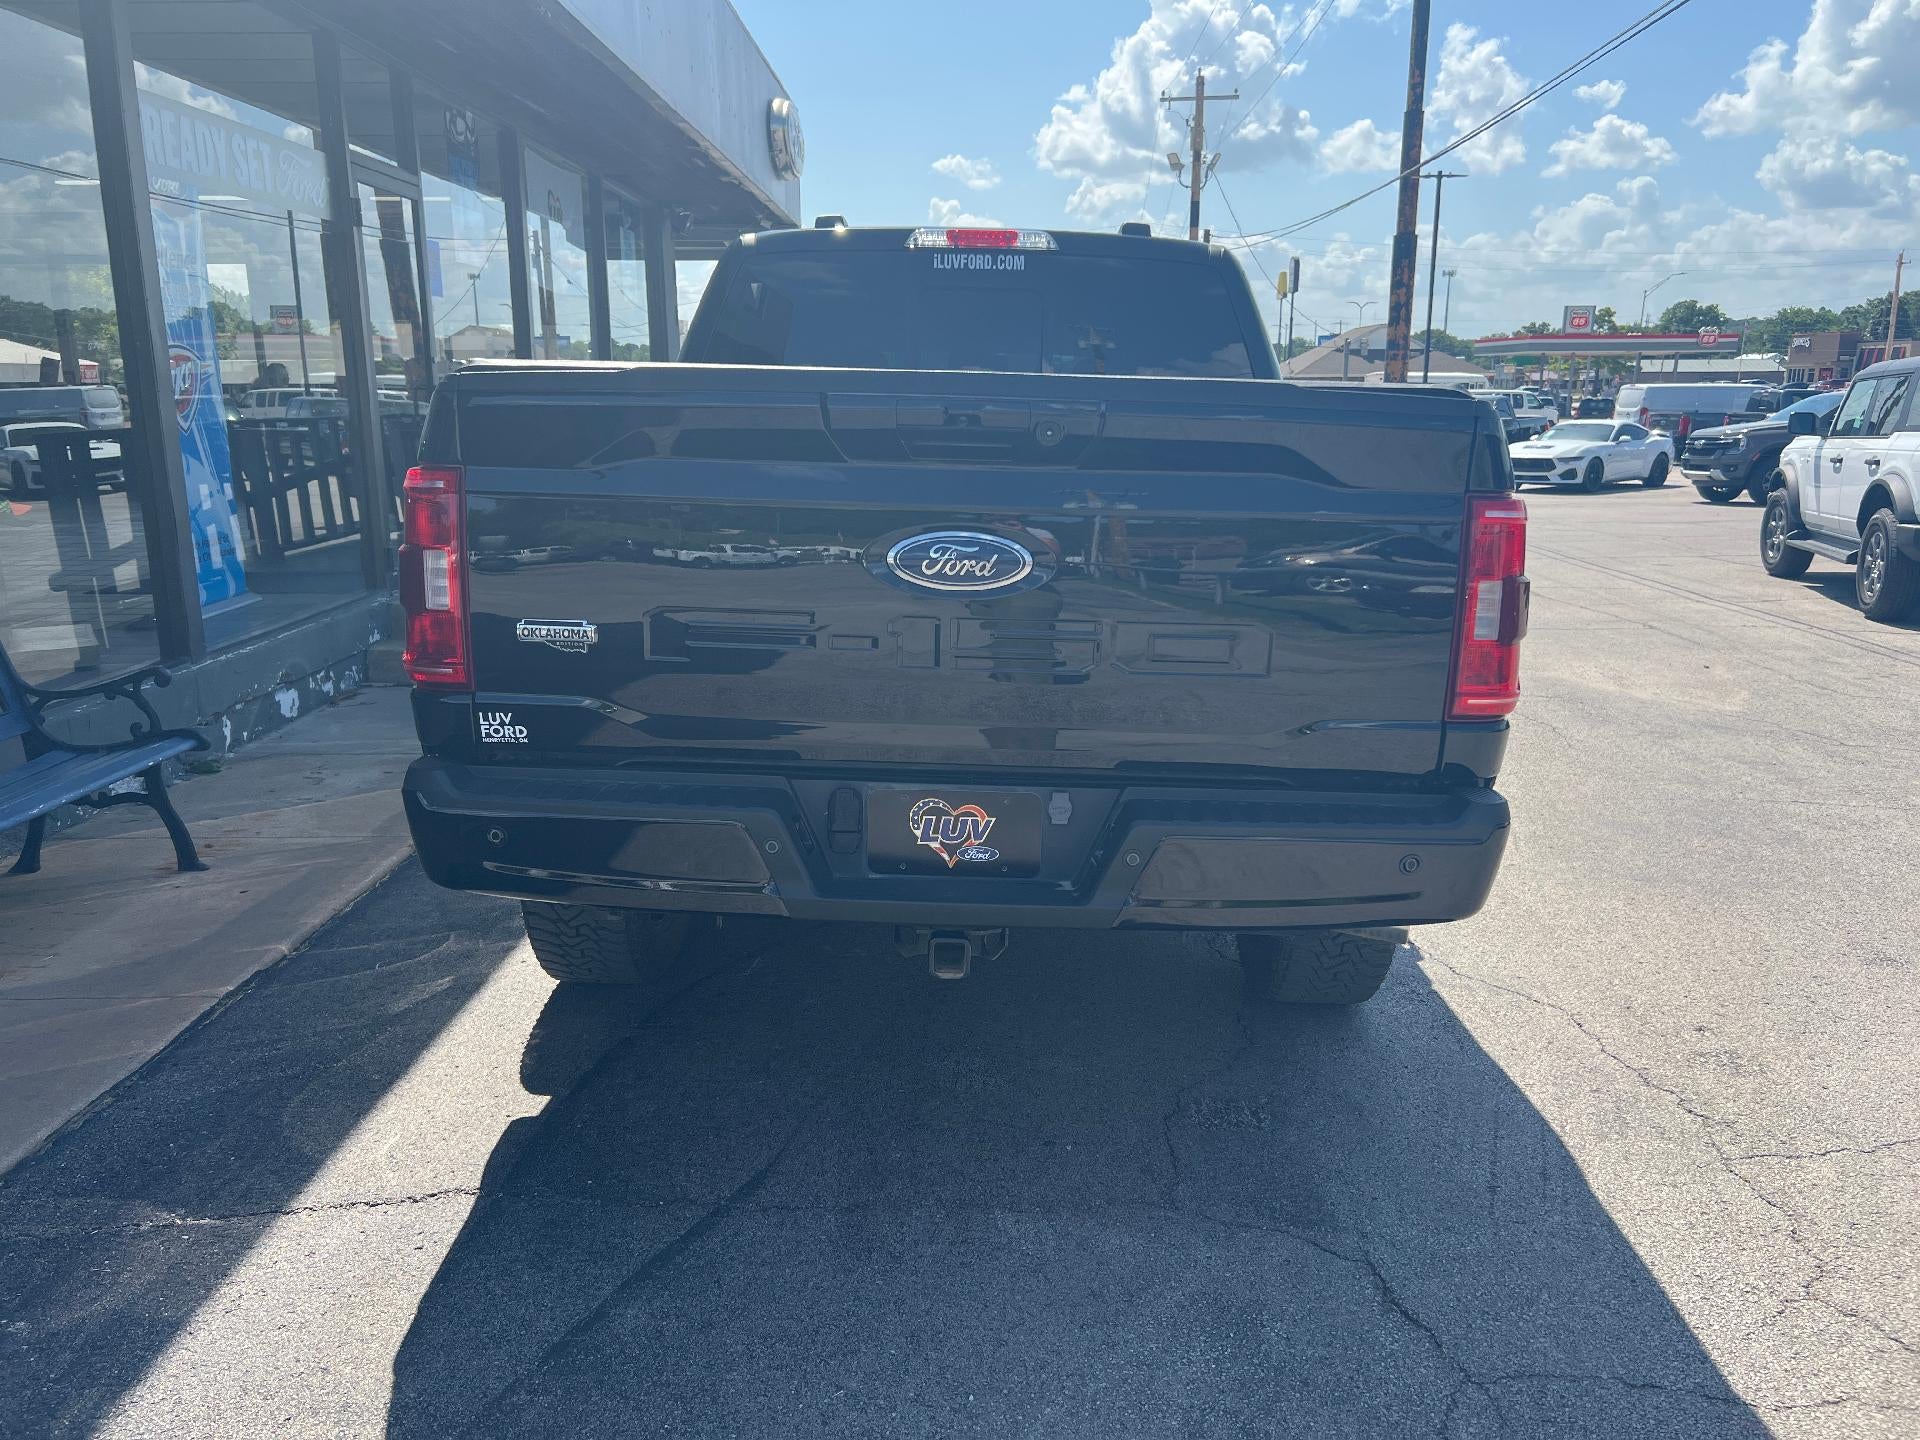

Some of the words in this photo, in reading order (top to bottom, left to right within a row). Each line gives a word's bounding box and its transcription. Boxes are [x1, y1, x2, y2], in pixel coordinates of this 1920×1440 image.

[140, 103, 227, 182] READY
[232, 133, 273, 193] SET
[276, 150, 330, 208] Ford
[933, 253, 1025, 271] iLUVFORD.COM
[921, 543, 999, 577] Ford
[521, 627, 590, 639] OKLAHOMA
[479, 712, 512, 725] LUV
[480, 725, 528, 738] FORD
[917, 815, 996, 845] LUV
[965, 848, 991, 859] Ford
